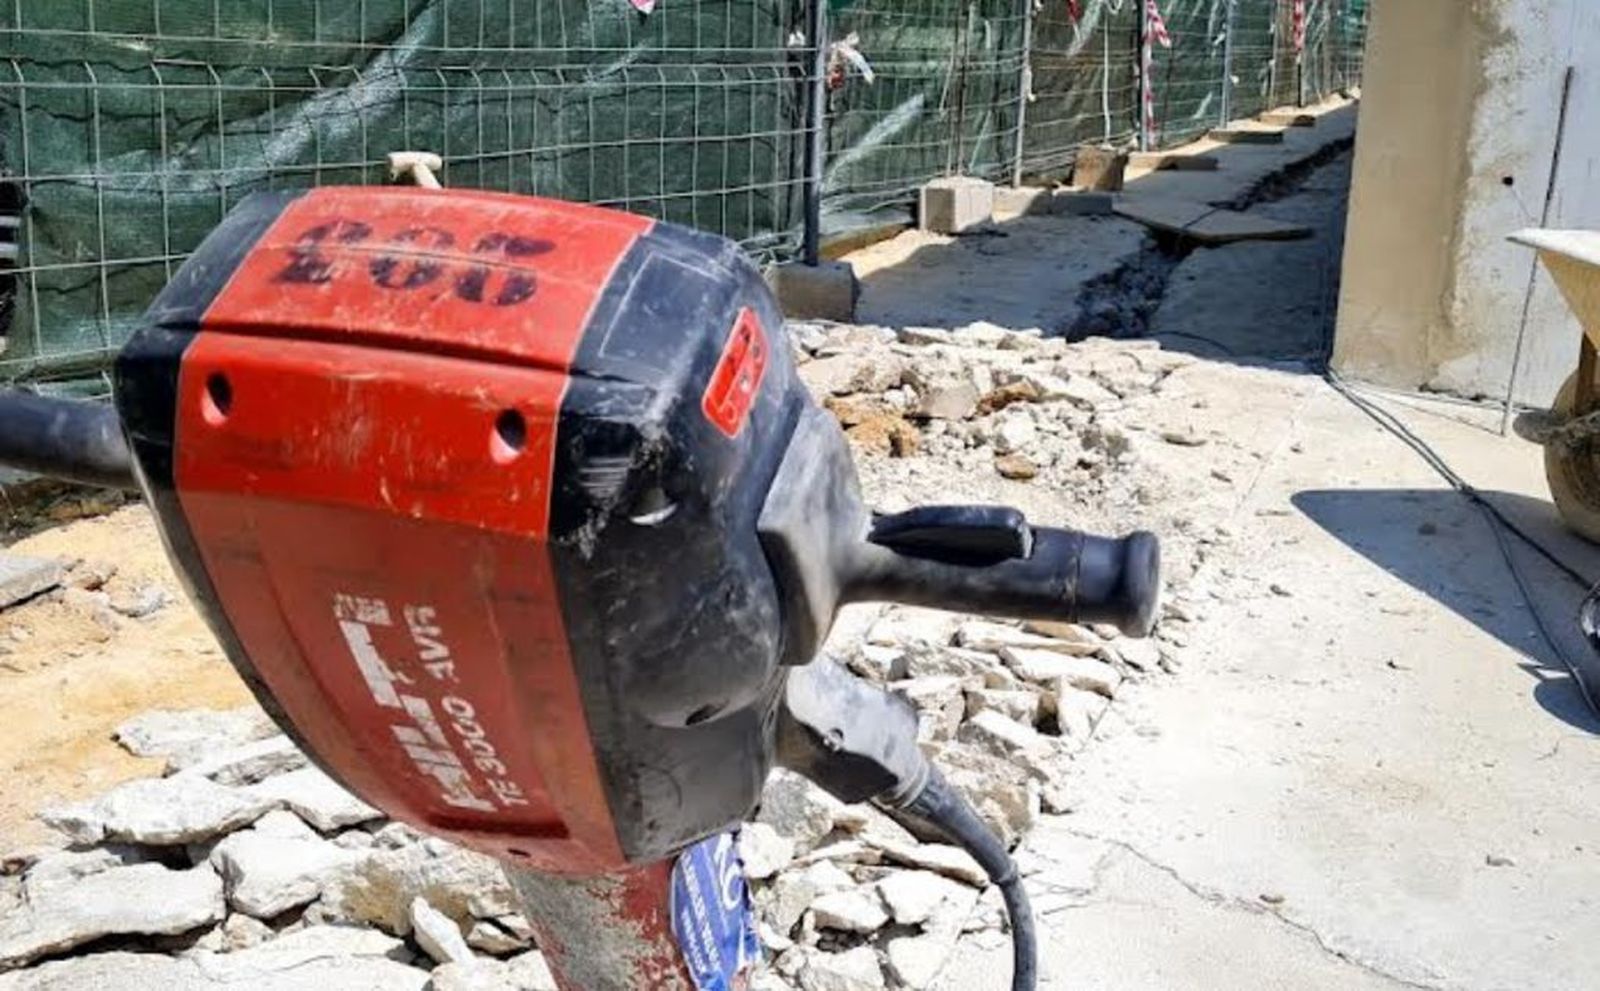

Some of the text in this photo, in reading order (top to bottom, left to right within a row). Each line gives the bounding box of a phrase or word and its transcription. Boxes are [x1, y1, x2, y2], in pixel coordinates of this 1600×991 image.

[332, 592, 499, 812] HILTI
[402, 603, 529, 806] TE 3000 AVR
